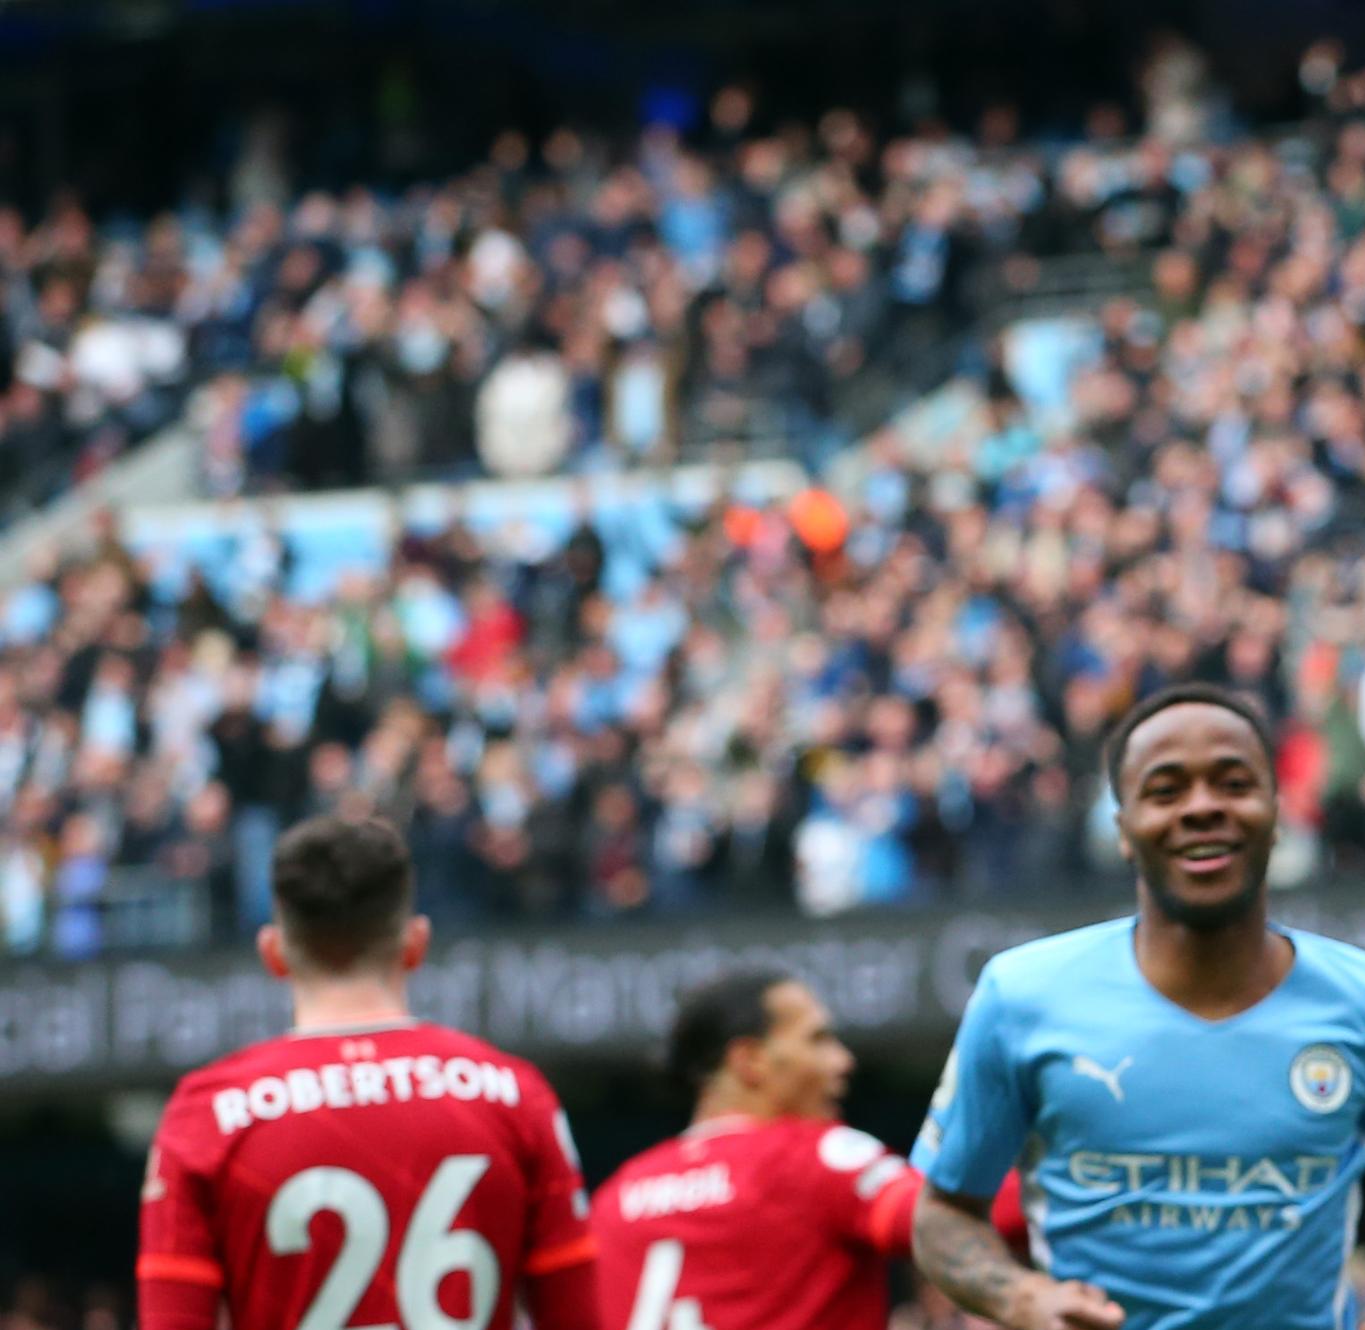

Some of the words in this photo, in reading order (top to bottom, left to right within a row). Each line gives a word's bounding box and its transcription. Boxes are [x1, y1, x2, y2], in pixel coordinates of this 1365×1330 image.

[212, 1053, 520, 1135] ROBERTSON
[1068, 1151, 1338, 1196] ETIHAD
[1108, 1203, 1301, 1232] AIRWAYS
